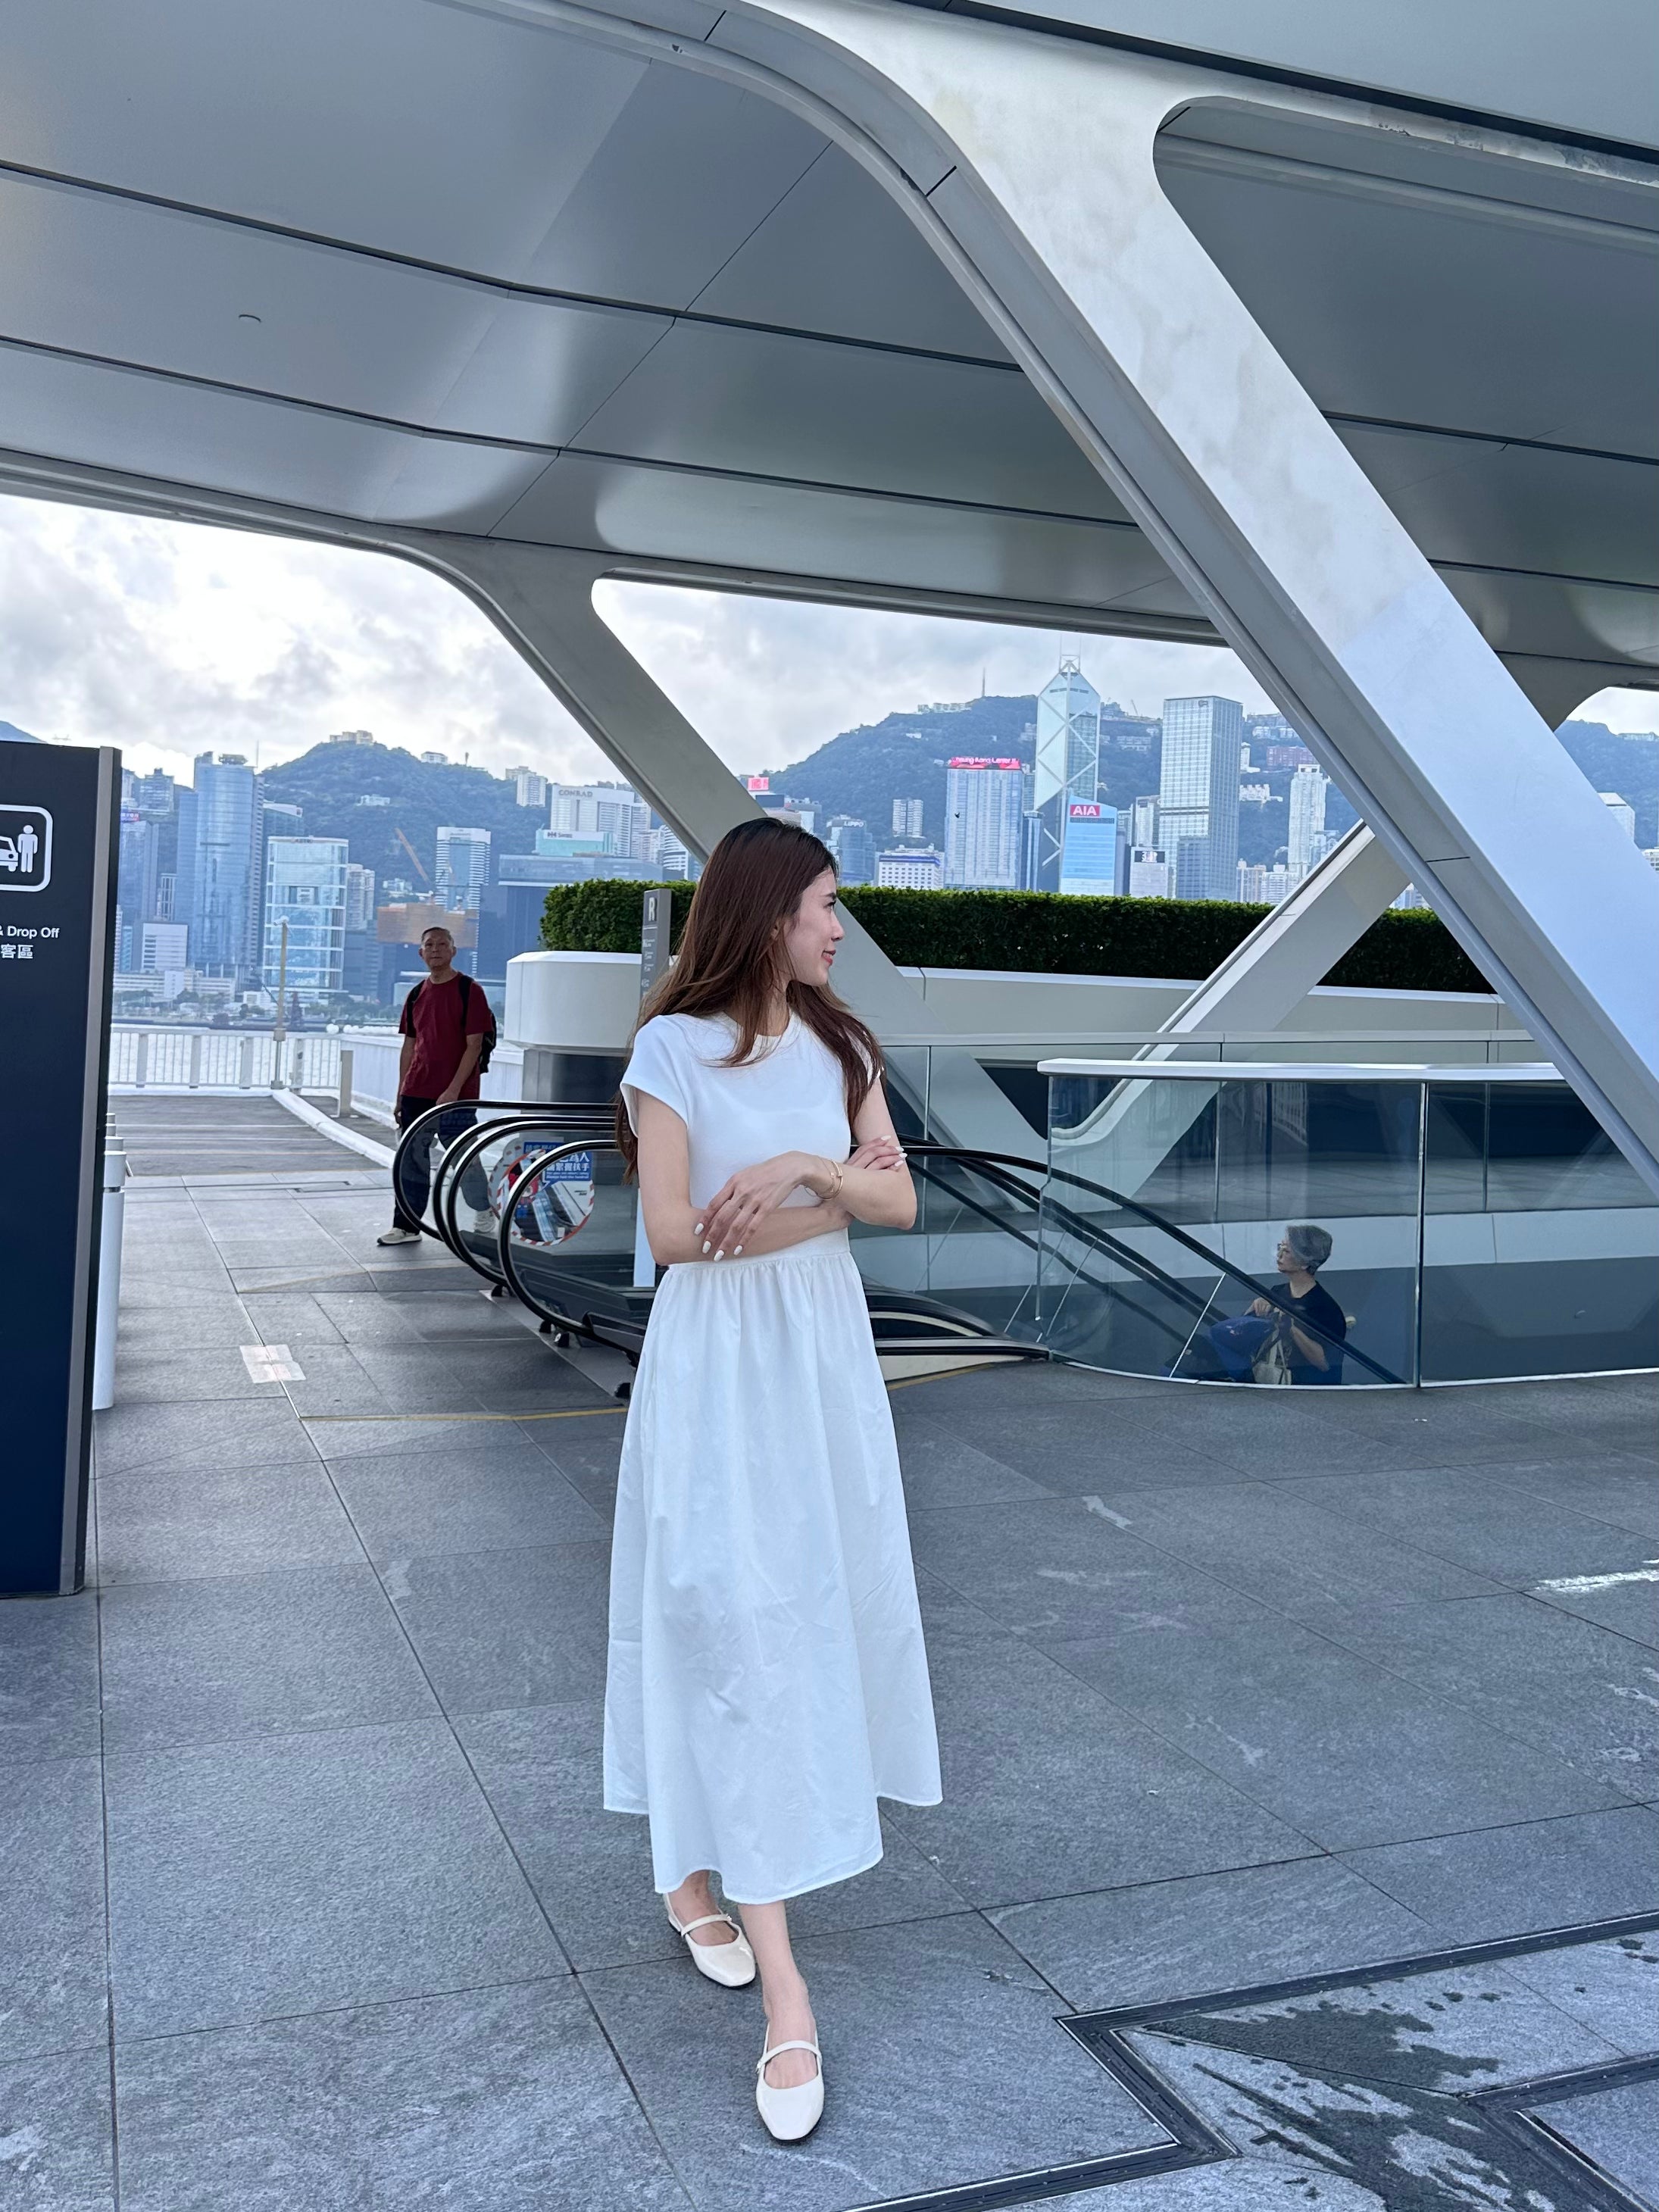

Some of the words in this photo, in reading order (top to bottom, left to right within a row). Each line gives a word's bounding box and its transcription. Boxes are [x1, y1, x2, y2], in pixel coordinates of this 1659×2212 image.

[558, 789, 593, 798] CONRAD
[1073, 805, 1097, 816] AIA
[648, 897, 656, 922] R
[7, 926, 38, 939] Drop
[40, 927, 60, 938] Off
[0, 943, 34, 959] 客區
